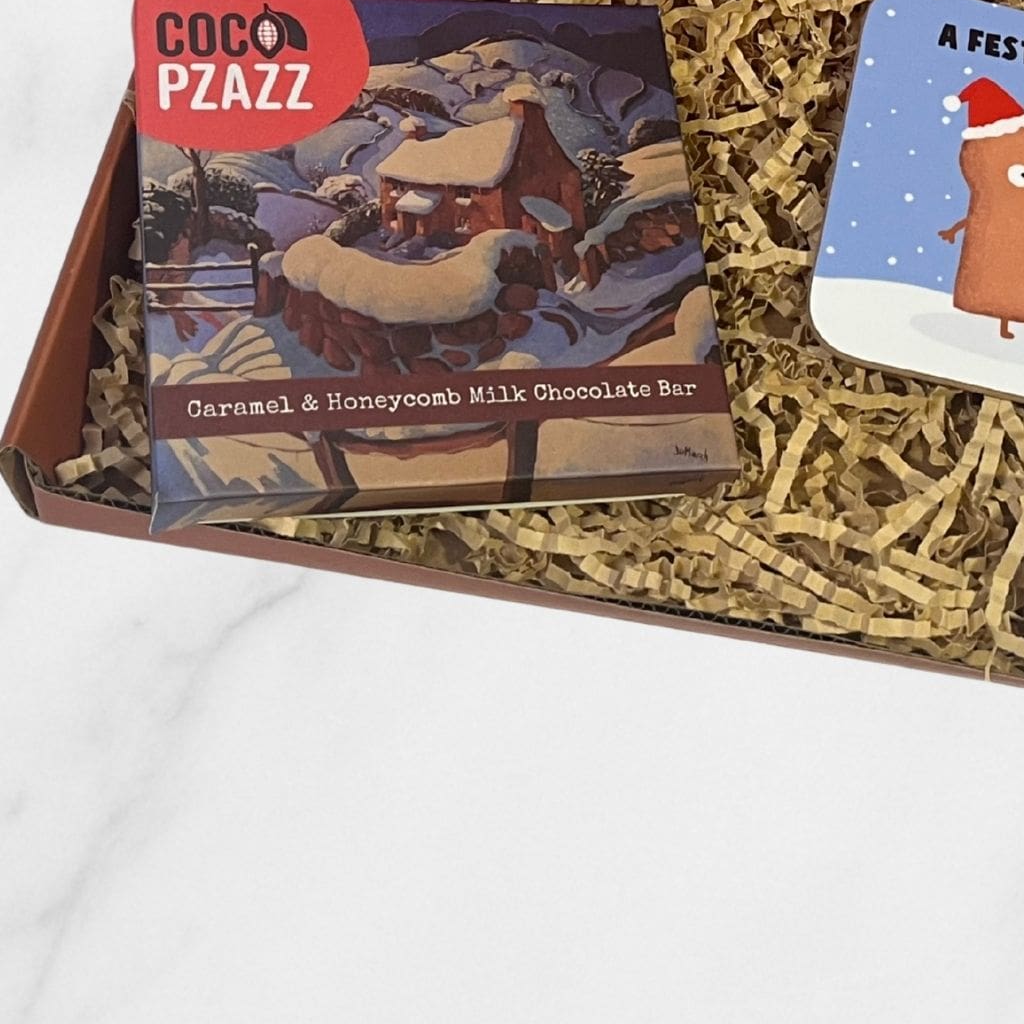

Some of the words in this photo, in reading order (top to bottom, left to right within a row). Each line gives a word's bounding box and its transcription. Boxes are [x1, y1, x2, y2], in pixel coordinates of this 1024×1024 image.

[156, 5, 298, 59] COCO
[938, 23, 957, 50] A
[157, 63, 314, 111] PZAZZ
[187, 395, 294, 418] Caramel
[301, 393, 319, 412] &
[327, 388, 462, 412] Honeycomb
[469, 384, 528, 404] Milk
[533, 379, 652, 402] Chocolate
[658, 378, 698, 398] Bar
